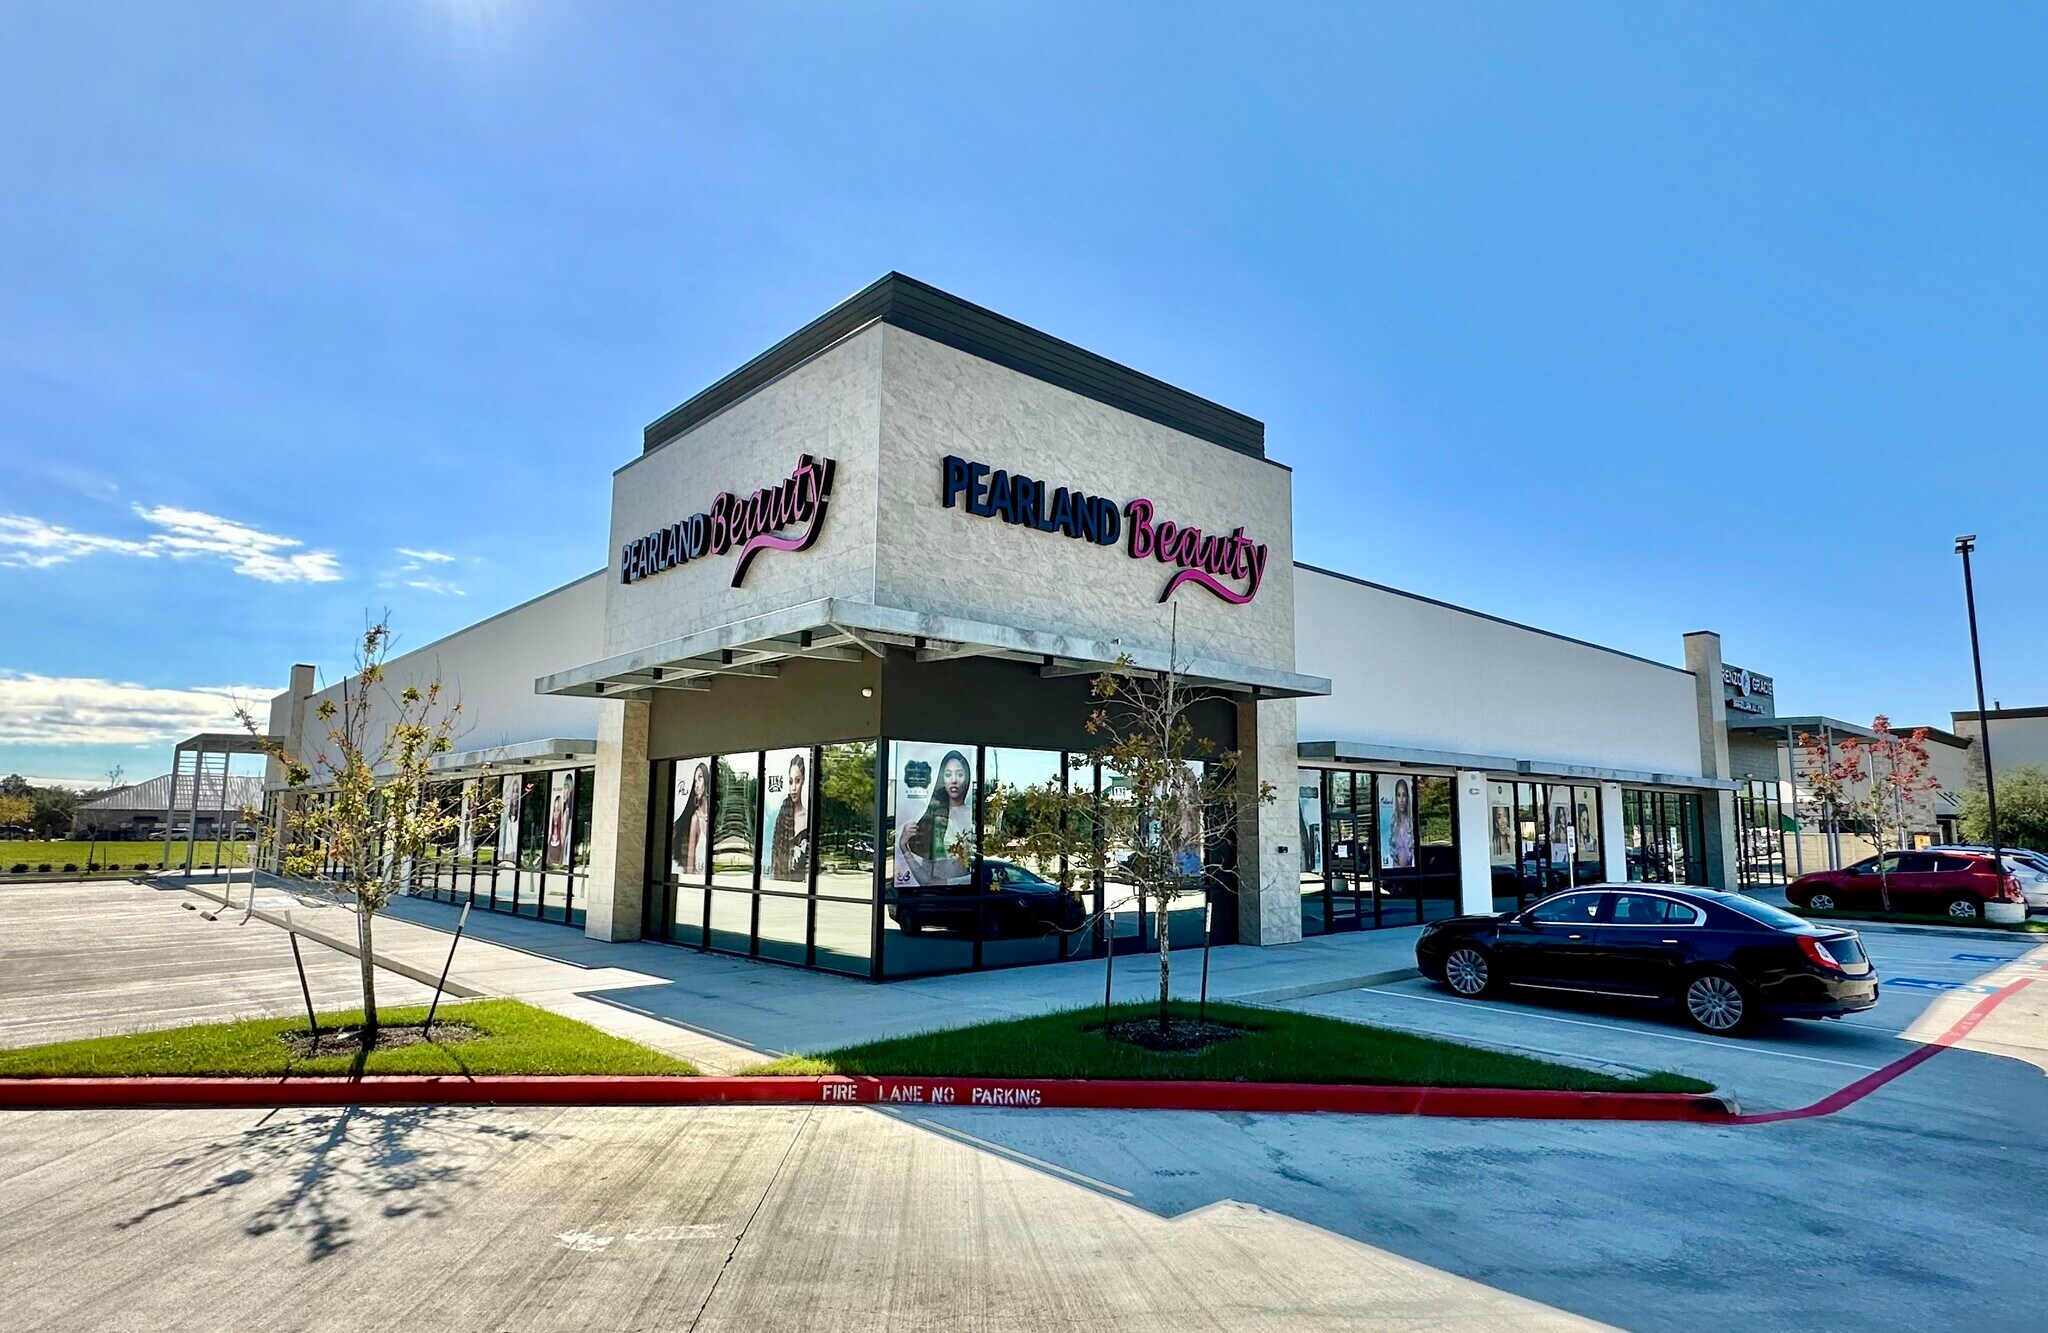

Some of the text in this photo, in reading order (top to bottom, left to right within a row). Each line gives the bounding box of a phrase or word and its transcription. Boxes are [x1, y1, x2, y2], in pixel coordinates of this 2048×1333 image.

[620, 453, 836, 588] PEARLAND Beauty
[942, 455, 1267, 604] PEARLAND Beauty
[822, 1084, 1041, 1105] FIRE LANE NO PARKING
